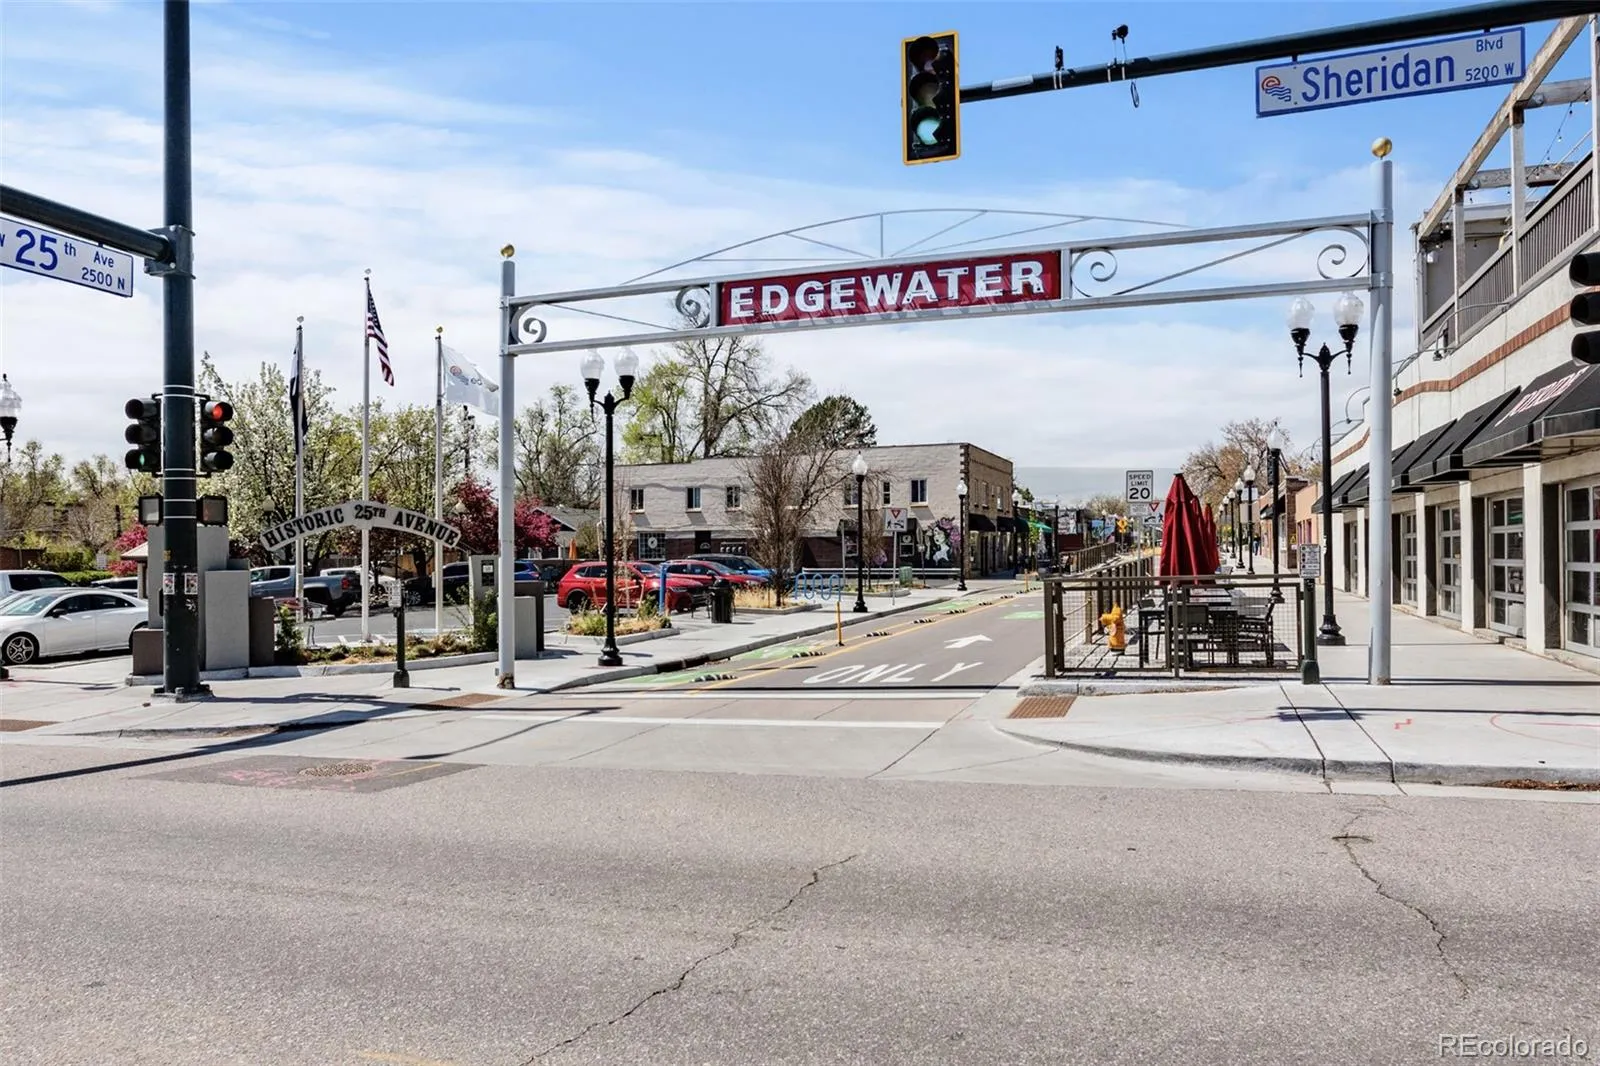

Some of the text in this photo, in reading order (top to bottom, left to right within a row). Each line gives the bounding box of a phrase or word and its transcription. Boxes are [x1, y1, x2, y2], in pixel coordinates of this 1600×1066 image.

[1302, 37, 1504, 102] Sheridan Blvd
[1465, 62, 1515, 82] 5200 W
[93, 250, 115, 268] Ave
[81, 266, 125, 290] 2500 N
[730, 260, 1045, 318] EDGEWATER
[1129, 487, 1150, 499] 20
[262, 504, 460, 548] HISTORIC 25TH AVENUE
[802, 662, 985, 684] ONLY
